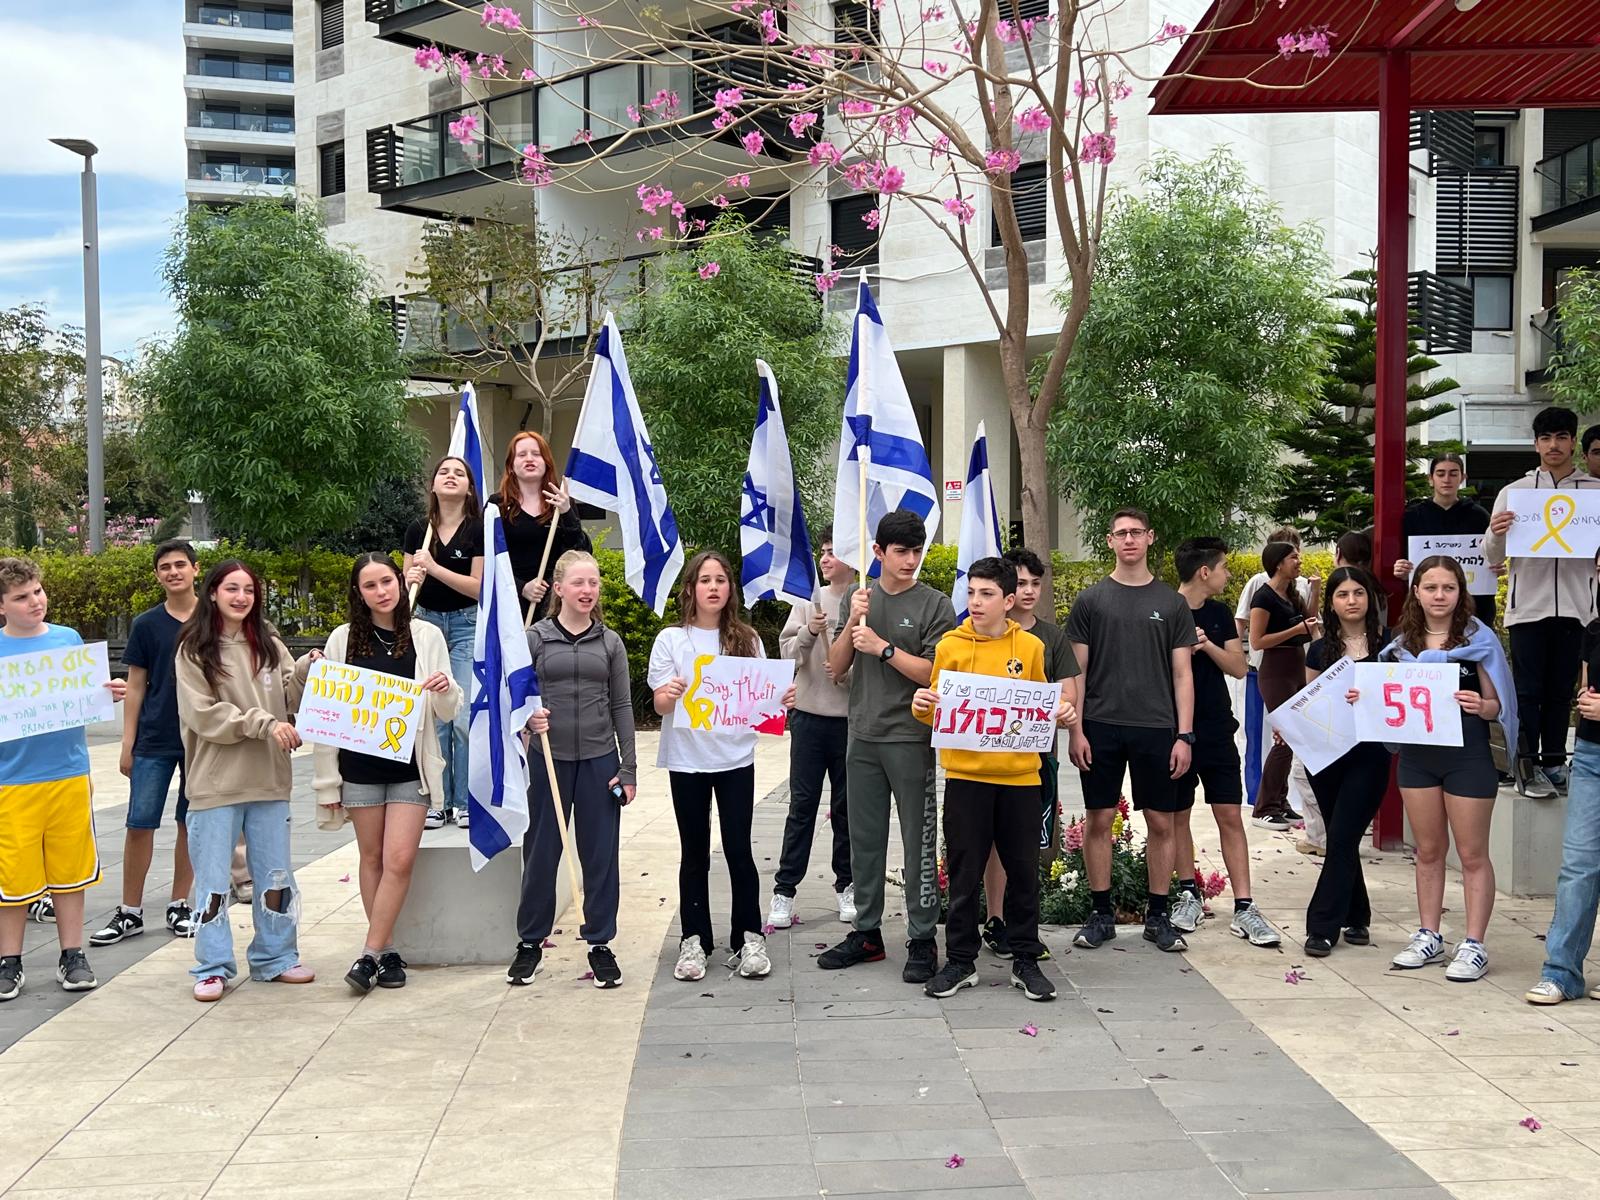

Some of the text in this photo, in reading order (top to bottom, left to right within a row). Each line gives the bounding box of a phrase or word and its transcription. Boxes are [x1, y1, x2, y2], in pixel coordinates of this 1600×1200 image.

[1551, 507, 1564, 516] 59
[1454, 554, 1485, 566] להחזי
[942, 679, 1056, 709] גיהנום של
[713, 703, 749, 726] Name
[934, 698, 1007, 735] כולנו
[1383, 683, 1434, 733] 59
[21, 719, 54, 737] BRING
[920, 768, 937, 908] SPORTSWEAR
